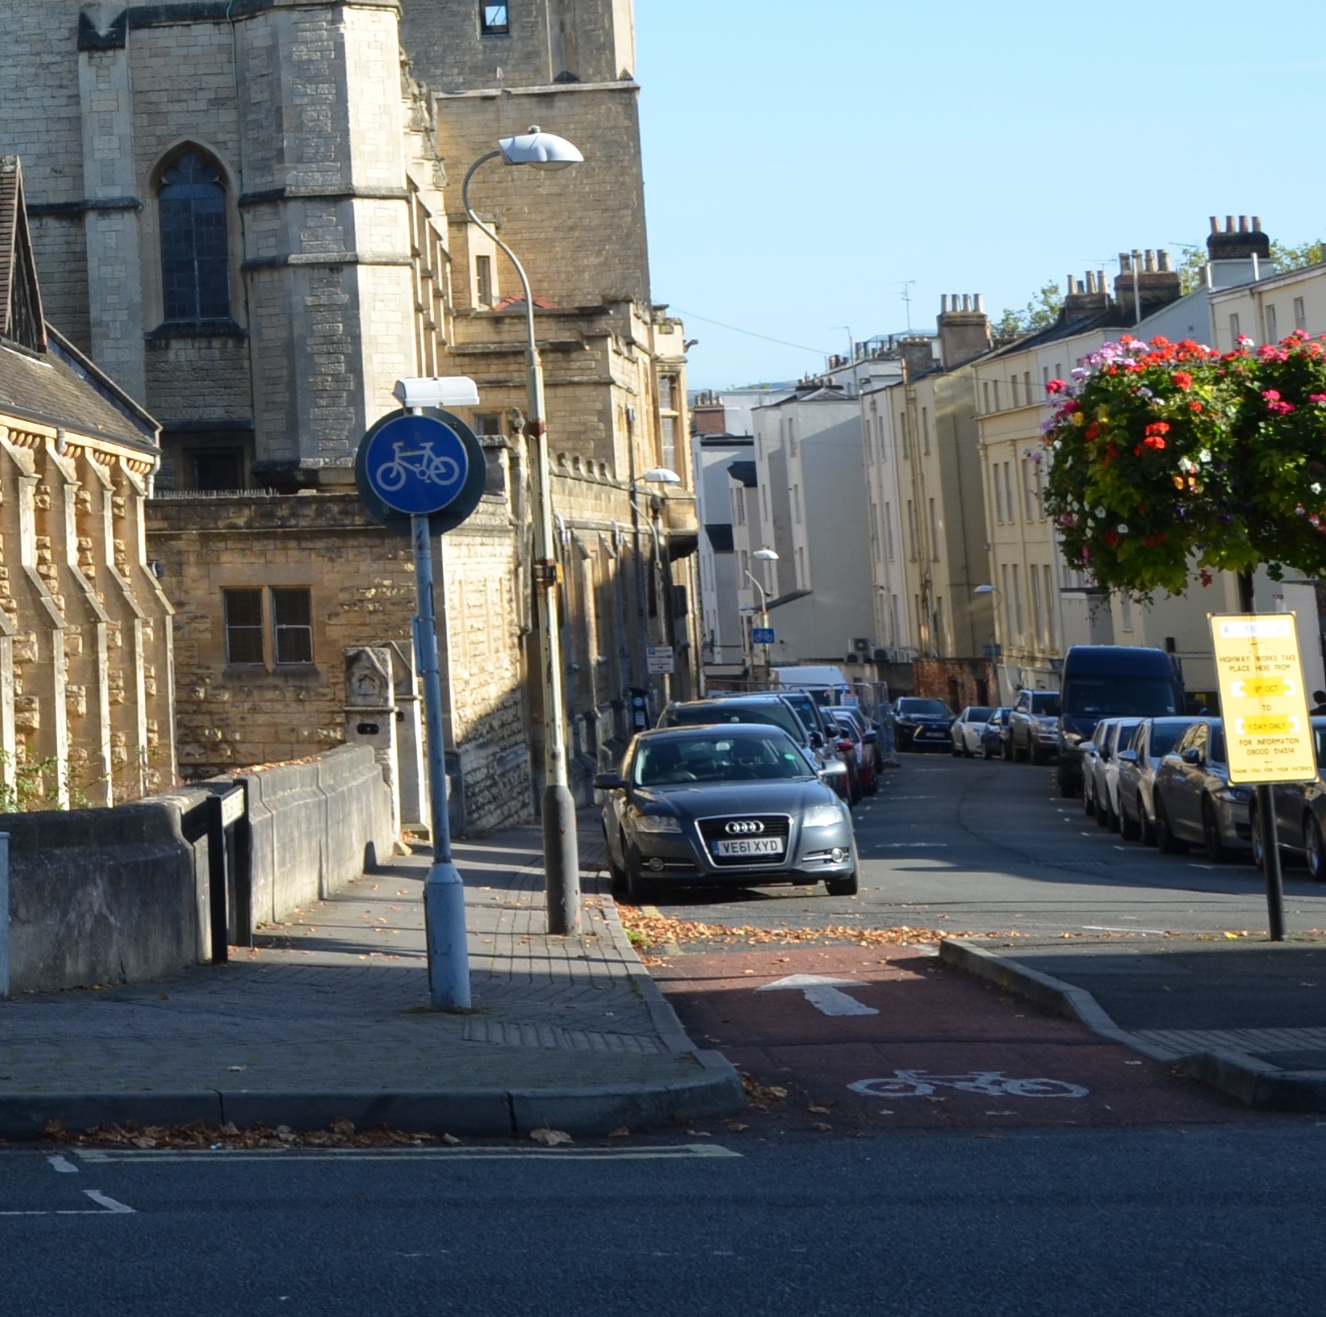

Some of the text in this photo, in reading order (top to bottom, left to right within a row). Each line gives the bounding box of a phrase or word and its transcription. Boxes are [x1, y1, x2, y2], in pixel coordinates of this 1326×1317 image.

[1264, 684, 1278, 693] OCT
[1261, 704, 1272, 712] TO
[1269, 722, 1286, 730] ONLY
[1257, 738, 1300, 746] INFORMATION
[722, 840, 778, 854] VE61 XYD
